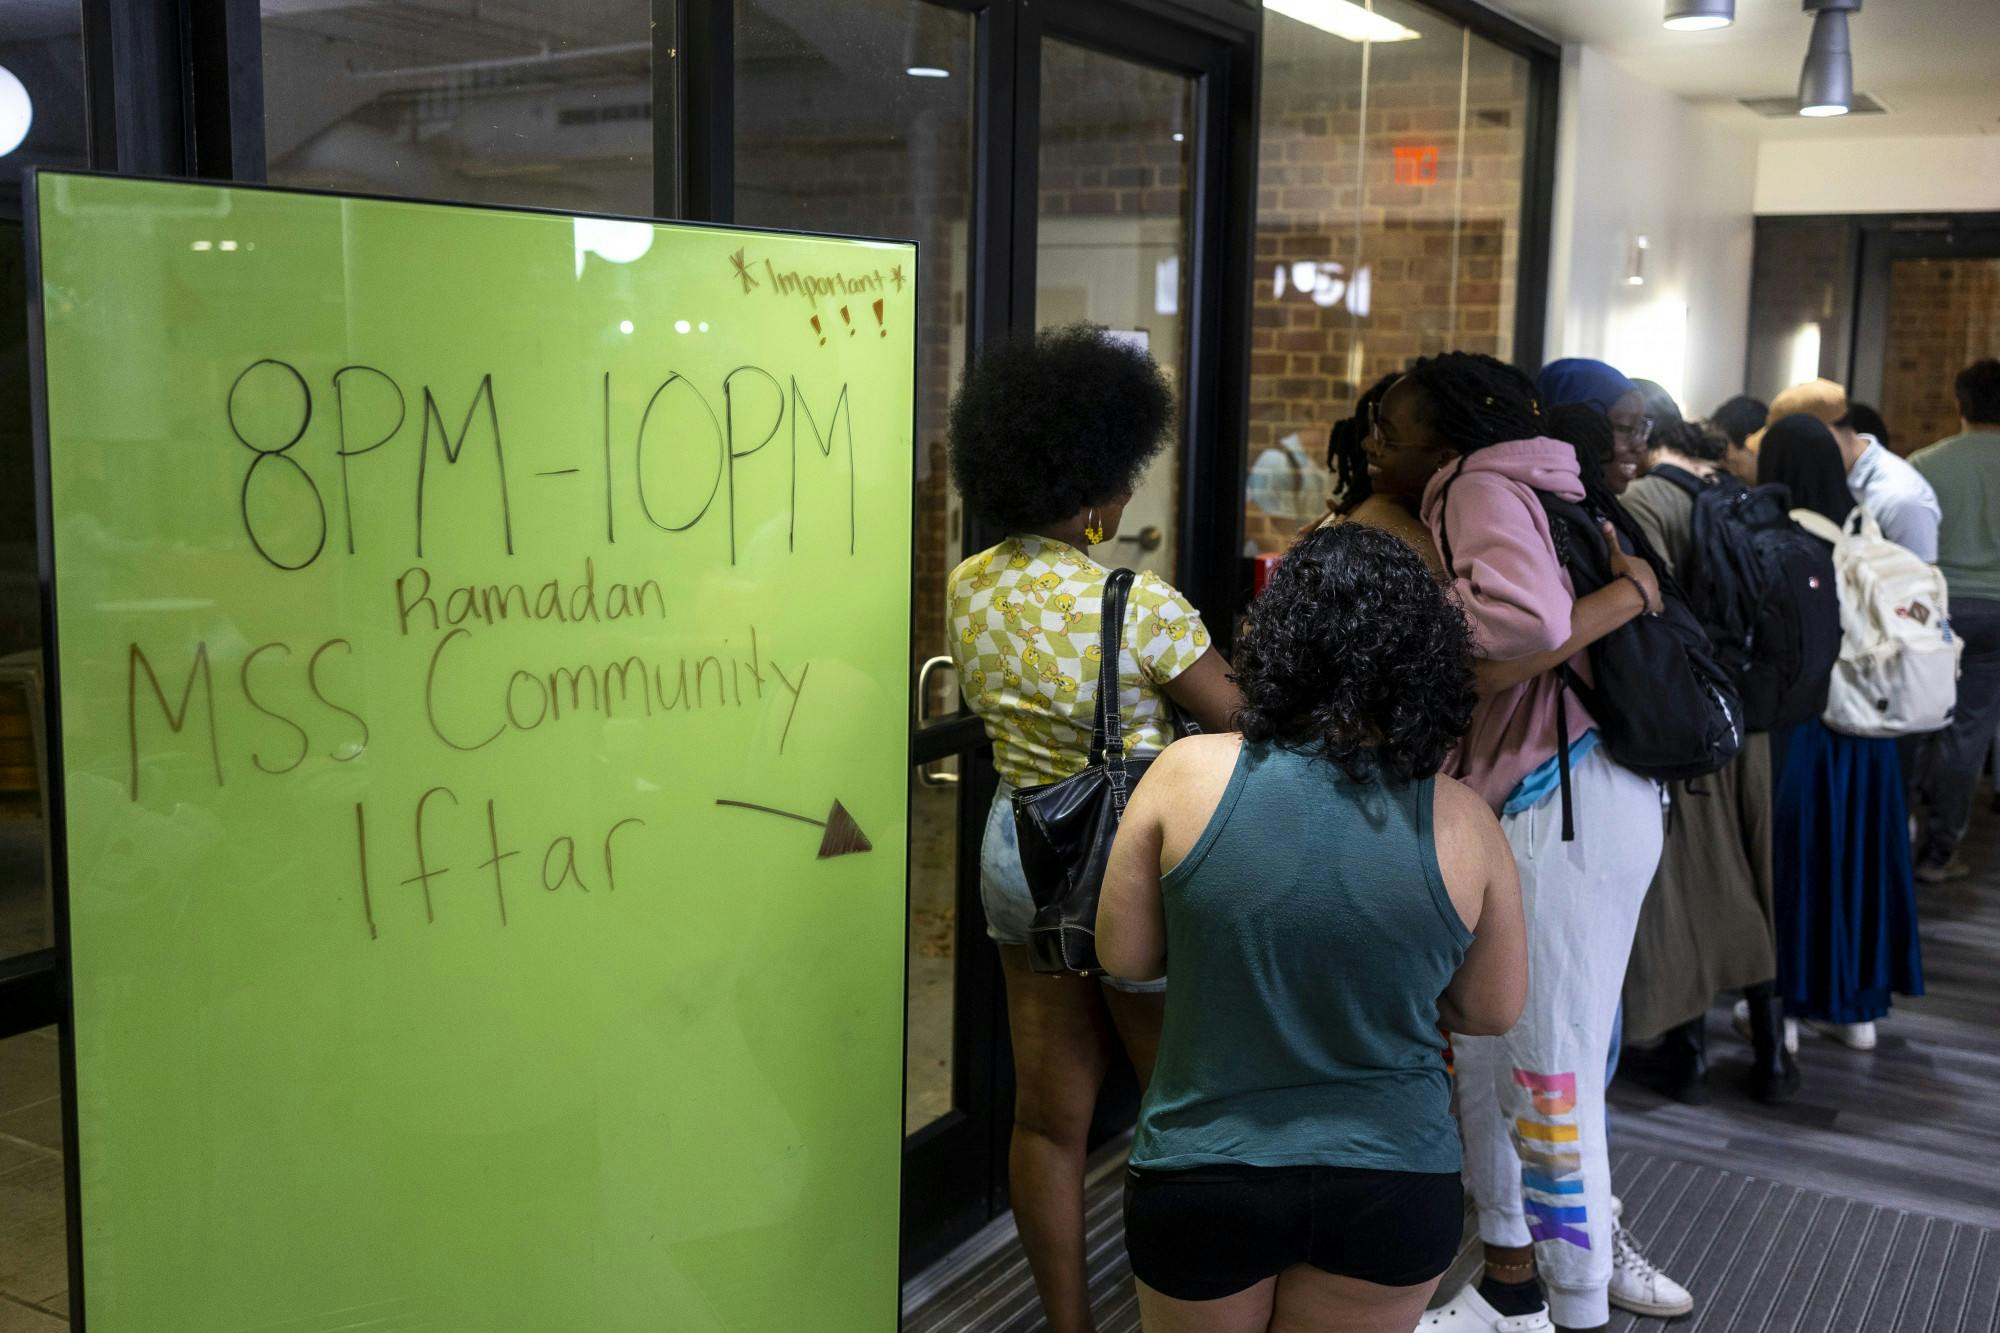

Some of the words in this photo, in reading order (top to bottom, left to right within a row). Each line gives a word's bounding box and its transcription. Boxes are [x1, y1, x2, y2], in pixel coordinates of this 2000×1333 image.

[395, 557, 665, 635] Ramadan
[129, 638, 370, 802] MSS
[427, 625, 810, 756] Community
[356, 787, 646, 940] Iftar
